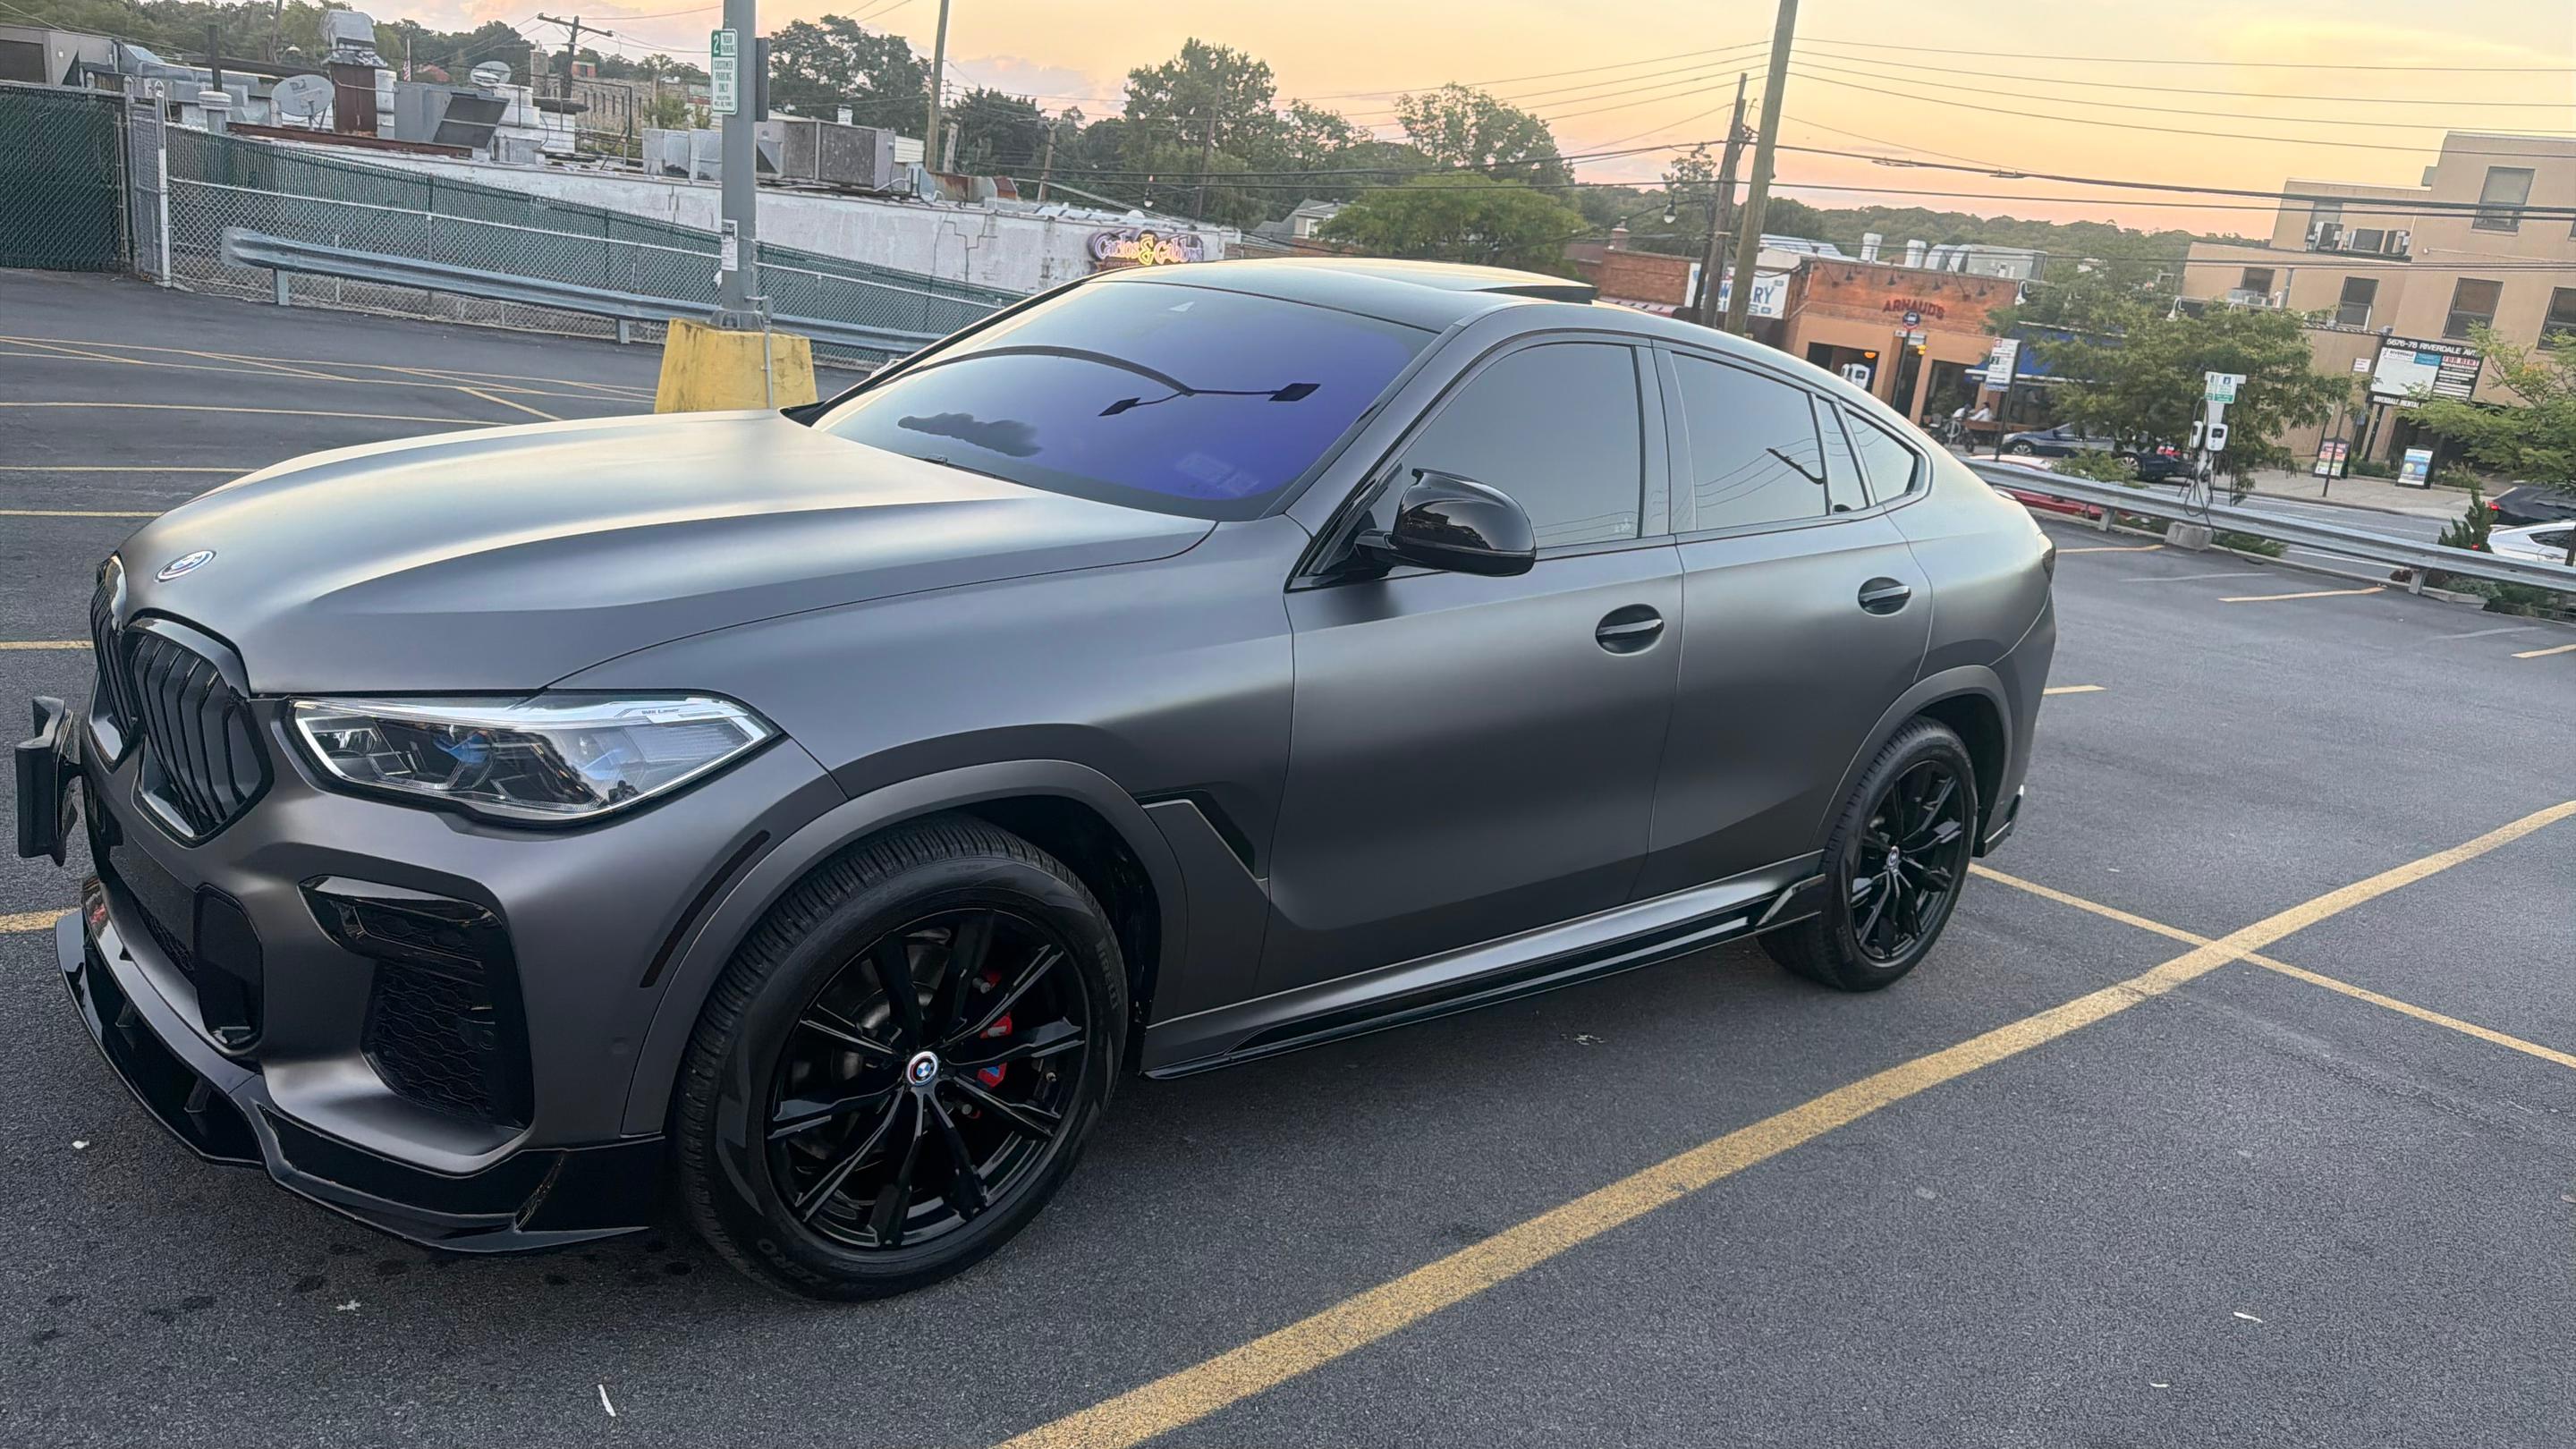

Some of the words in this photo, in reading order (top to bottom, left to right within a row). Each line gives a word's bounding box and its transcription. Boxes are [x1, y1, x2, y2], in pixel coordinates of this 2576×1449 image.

[713, 34, 719, 54] 2
[715, 60, 733, 70] CUSTOMER
[716, 72, 732, 81] PARKING
[718, 82, 728, 93] ONLY
[1095, 233, 1140, 259] Carlos
[2386, 338, 2418, 349] 5676-78
[2419, 343, 2462, 354] RIVERDALE
[2460, 358, 2479, 367] RENT
